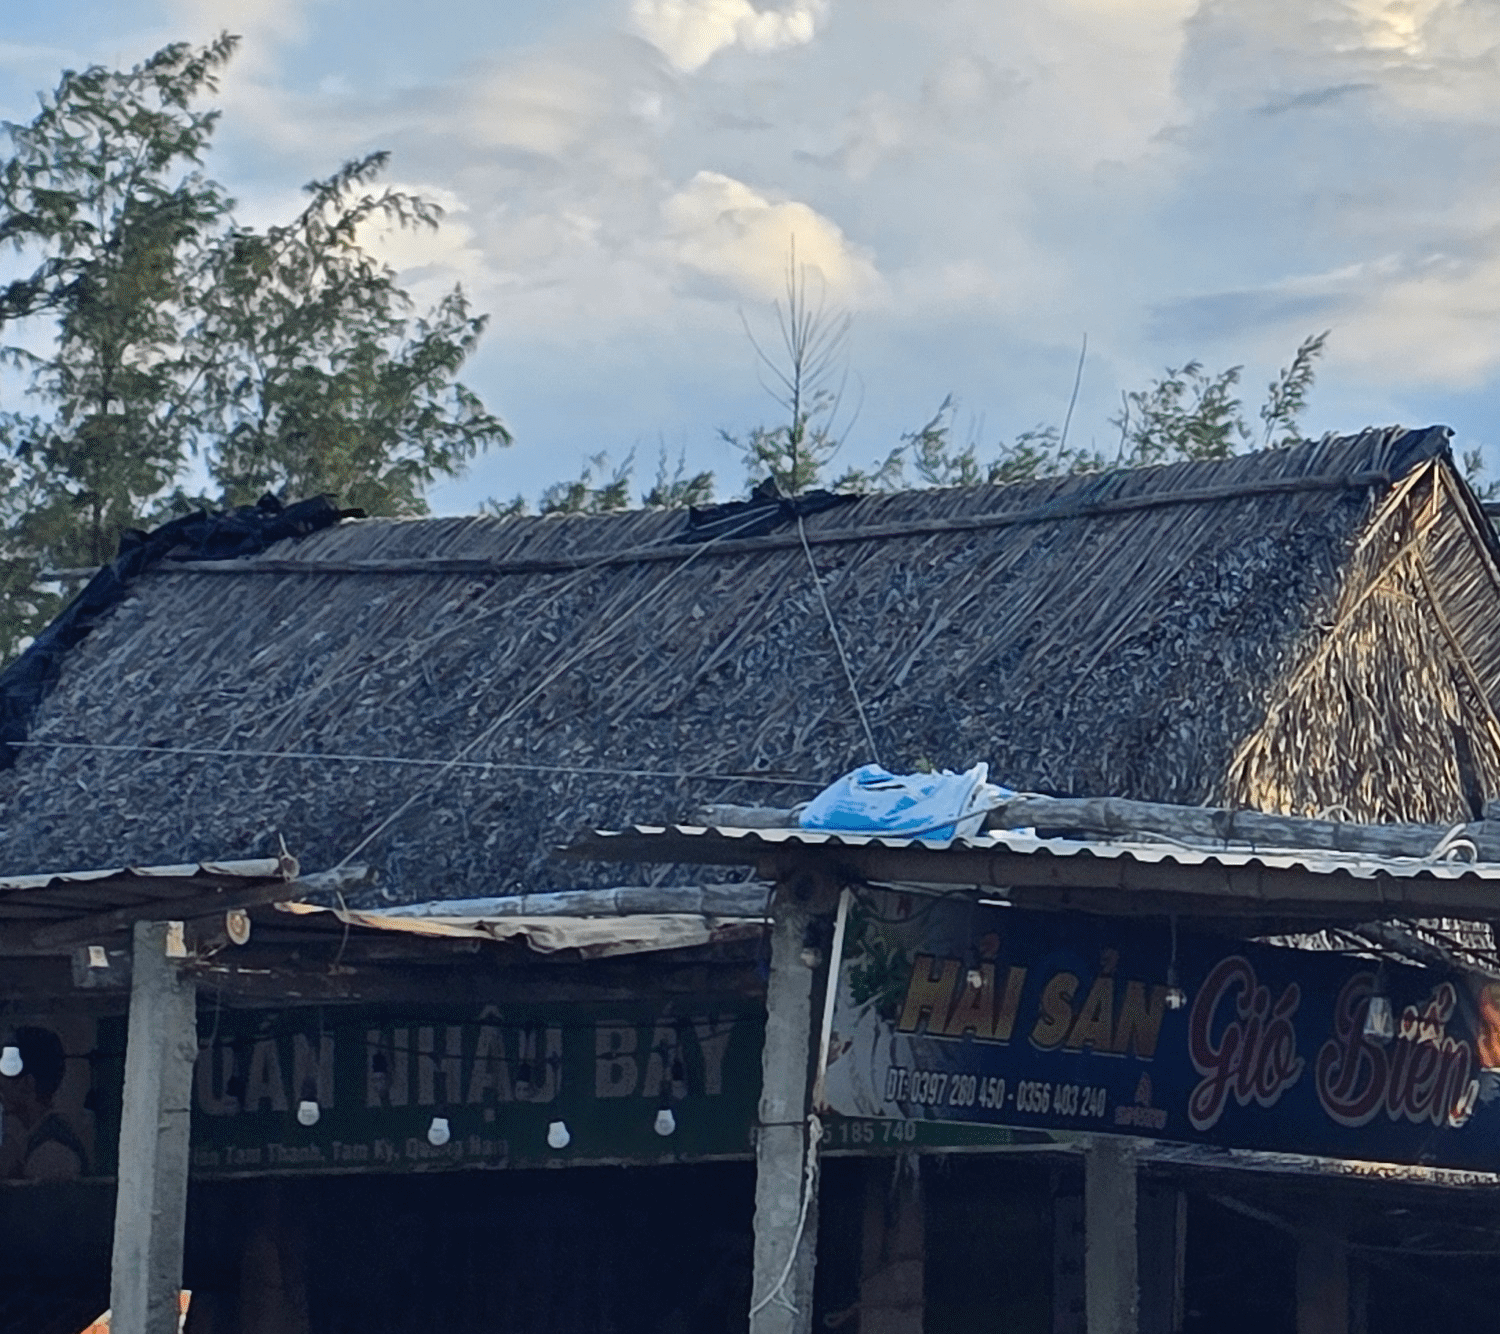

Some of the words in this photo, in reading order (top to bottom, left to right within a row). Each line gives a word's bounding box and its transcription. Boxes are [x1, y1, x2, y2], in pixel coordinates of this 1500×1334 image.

[895, 932, 1028, 1046] HẢI
[1029, 947, 1168, 1062] SẢN
[1187, 955, 1305, 1131] Gió
[1315, 971, 1481, 1128] Biển
[196, 1013, 335, 1117] UÁN
[909, 1070, 948, 1105] 0397
[977, 1077, 1005, 1110] 450
[1016, 1080, 1051, 1114] 0356
[1052, 1083, 1080, 1117] 403
[839, 1122, 875, 1144] 185
[881, 1120, 917, 1142] 740
